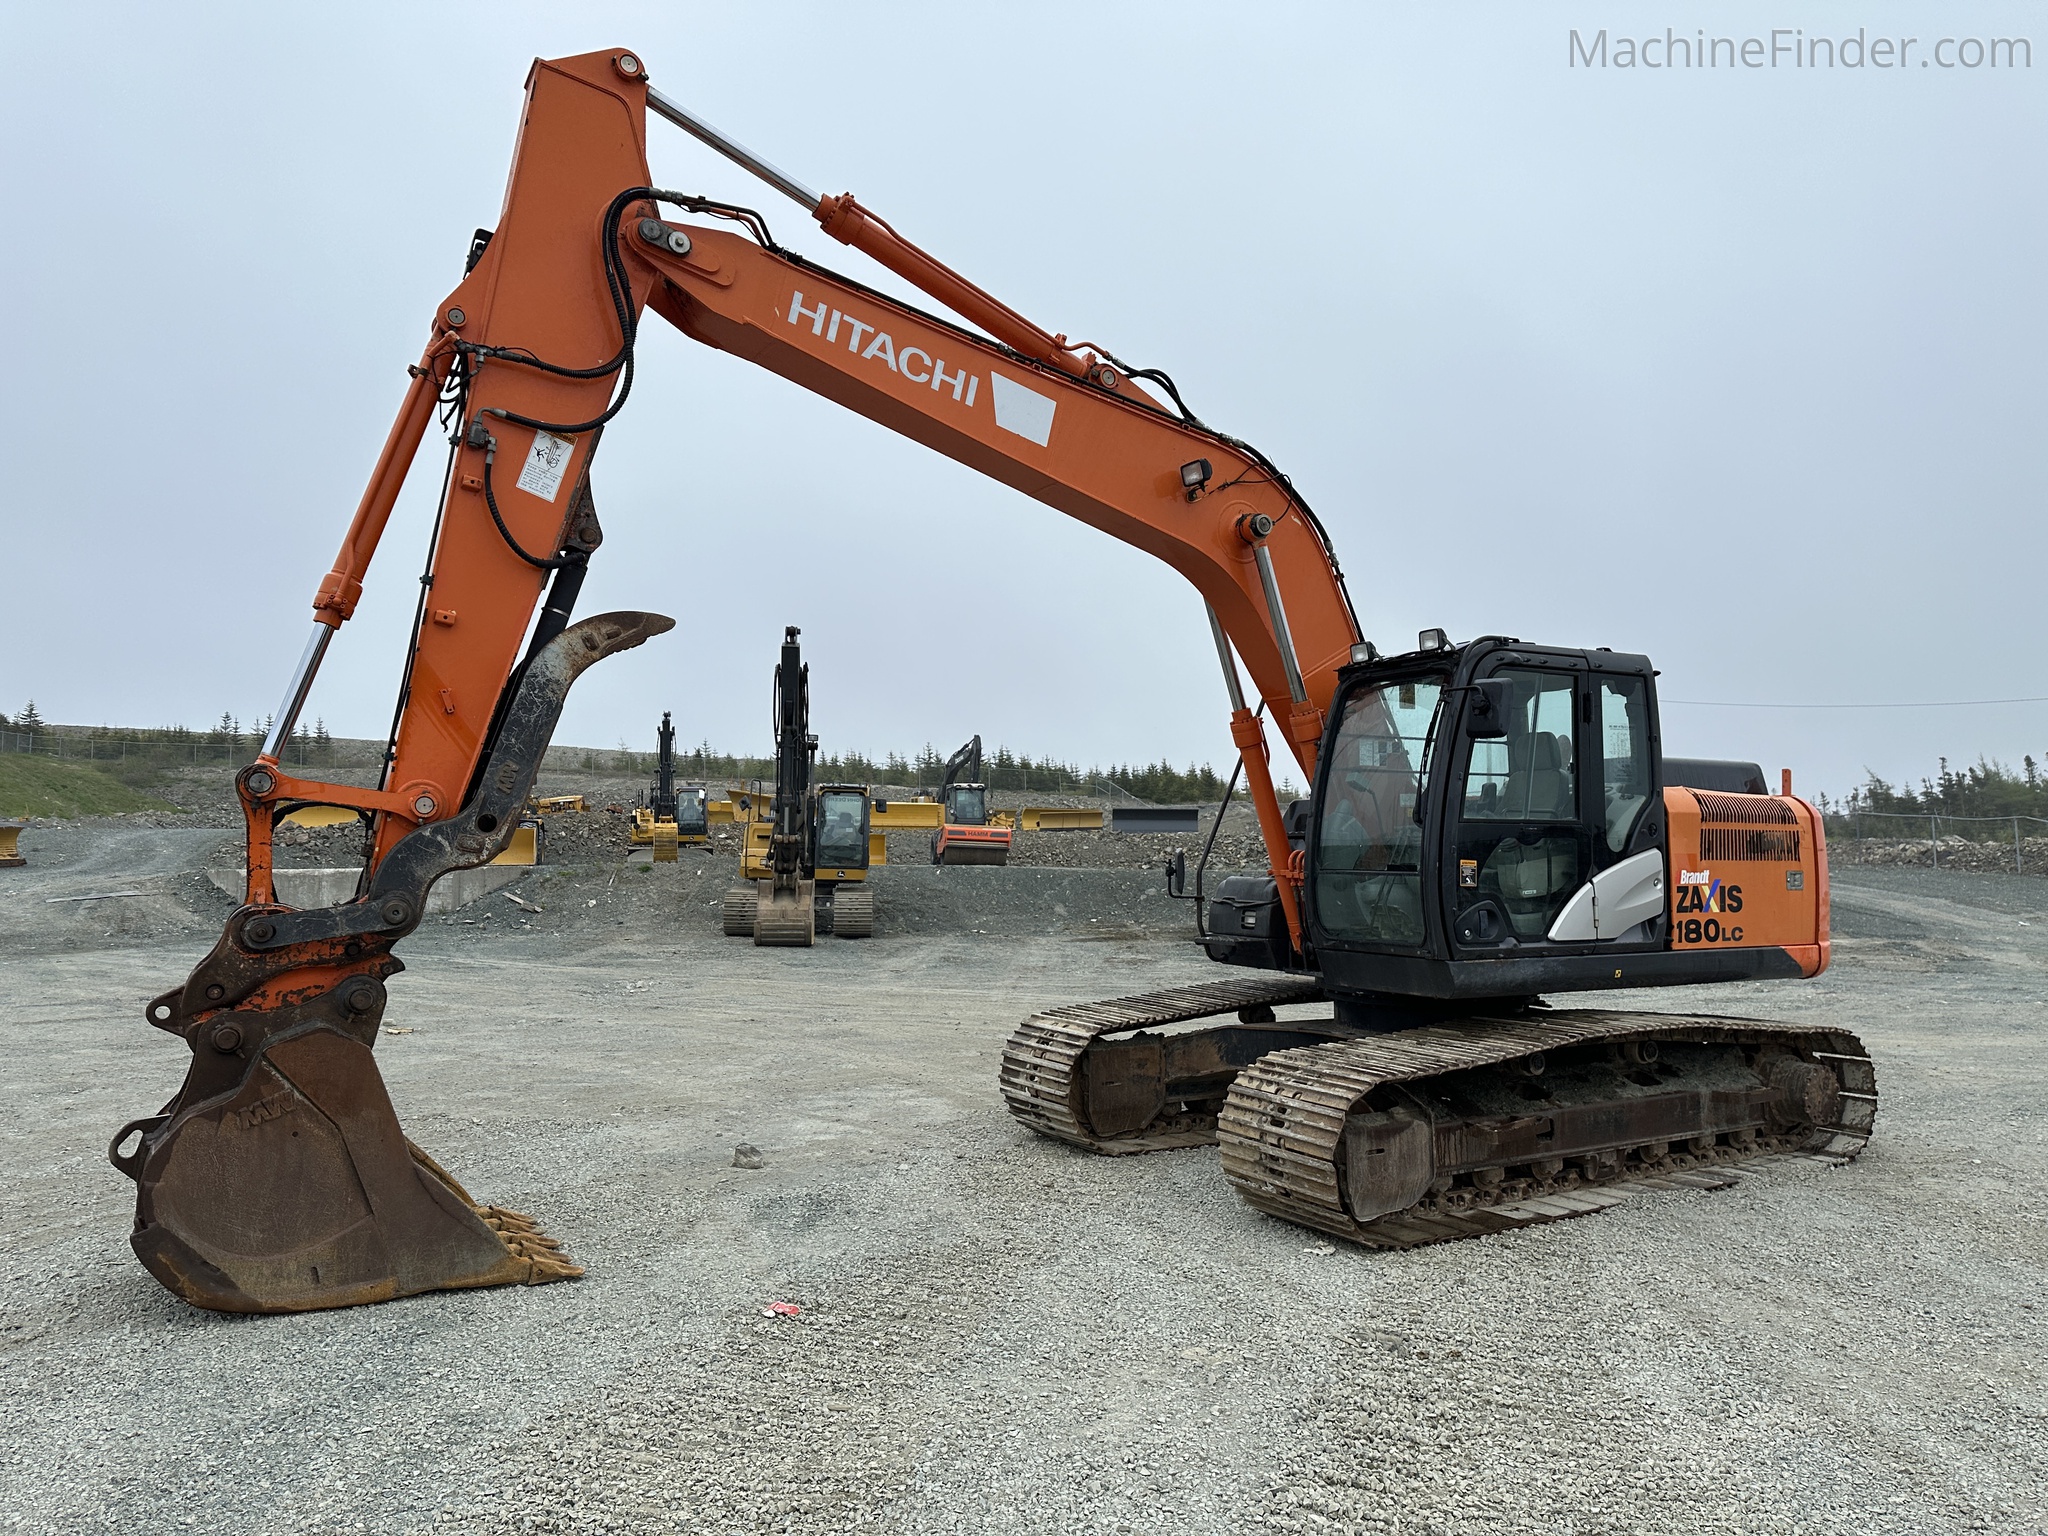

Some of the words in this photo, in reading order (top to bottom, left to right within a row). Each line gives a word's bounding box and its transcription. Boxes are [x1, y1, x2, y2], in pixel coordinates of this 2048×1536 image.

[787, 290, 979, 407] HITACHI
[1680, 869, 1710, 885] Brandt
[1676, 879, 1743, 913] ZAXIS
[237, 1089, 295, 1129] MW
